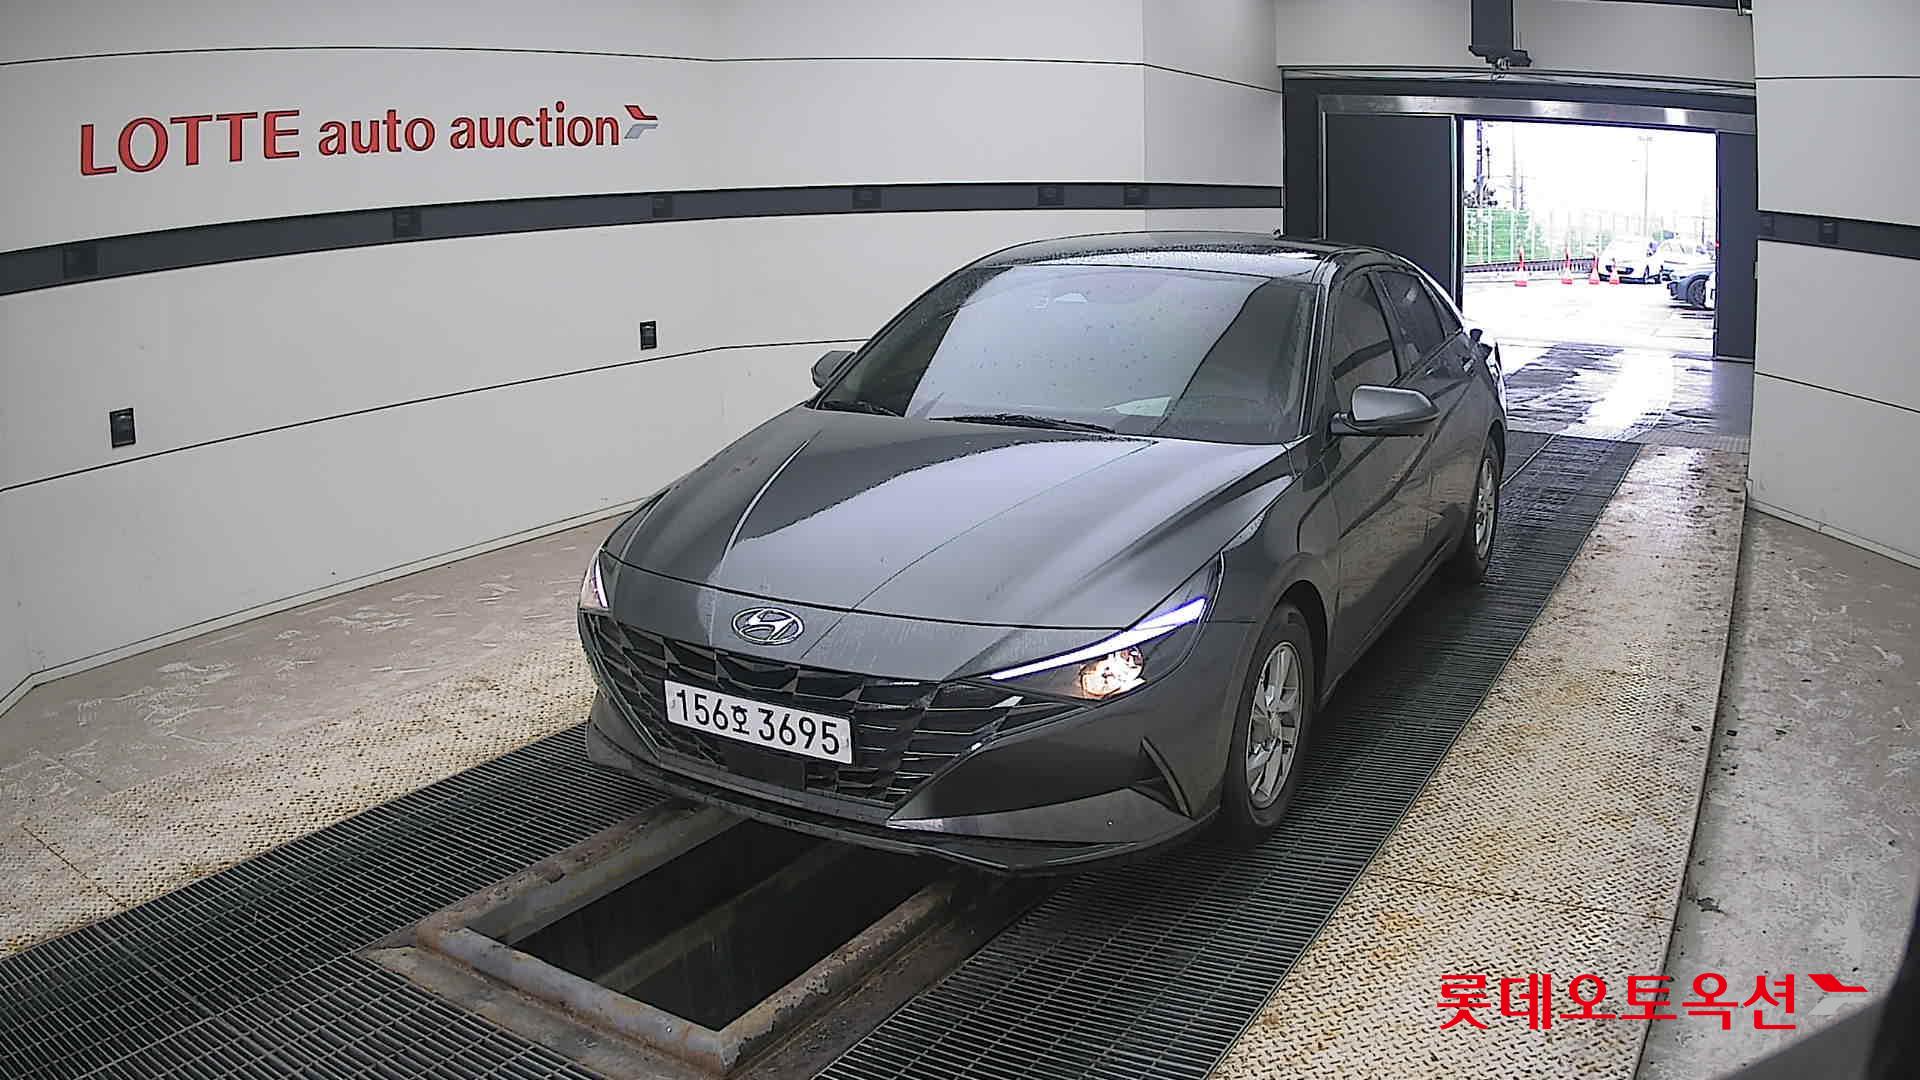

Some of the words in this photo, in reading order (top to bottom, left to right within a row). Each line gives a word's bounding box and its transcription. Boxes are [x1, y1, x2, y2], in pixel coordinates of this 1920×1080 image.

[80, 110, 300, 176] LOTTE
[317, 108, 436, 156] auto
[449, 100, 620, 150] auction
[676, 689, 750, 735] 156호
[757, 707, 840, 755] 3695
